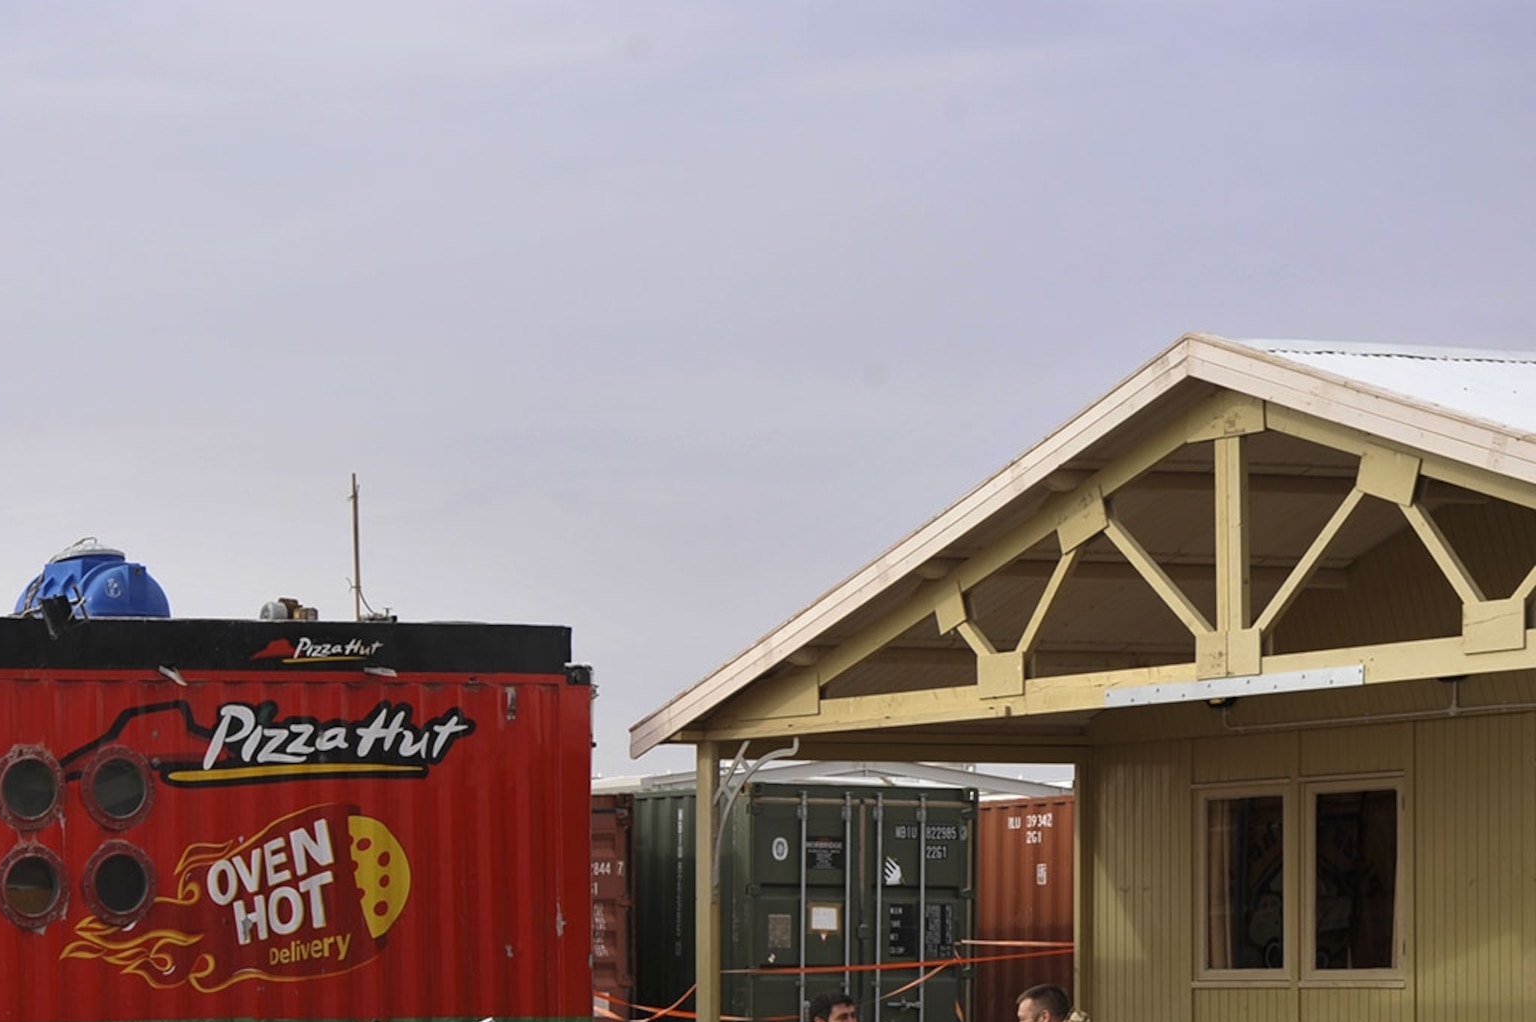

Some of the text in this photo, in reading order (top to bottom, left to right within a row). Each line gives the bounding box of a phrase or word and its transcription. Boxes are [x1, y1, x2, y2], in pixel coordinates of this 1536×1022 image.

[293, 637, 384, 659] Pizza Hut
[203, 704, 469, 770] Pizza Hut
[206, 818, 335, 906] OVEN
[233, 870, 334, 945] HOT
[269, 933, 352, 965] Delivery
